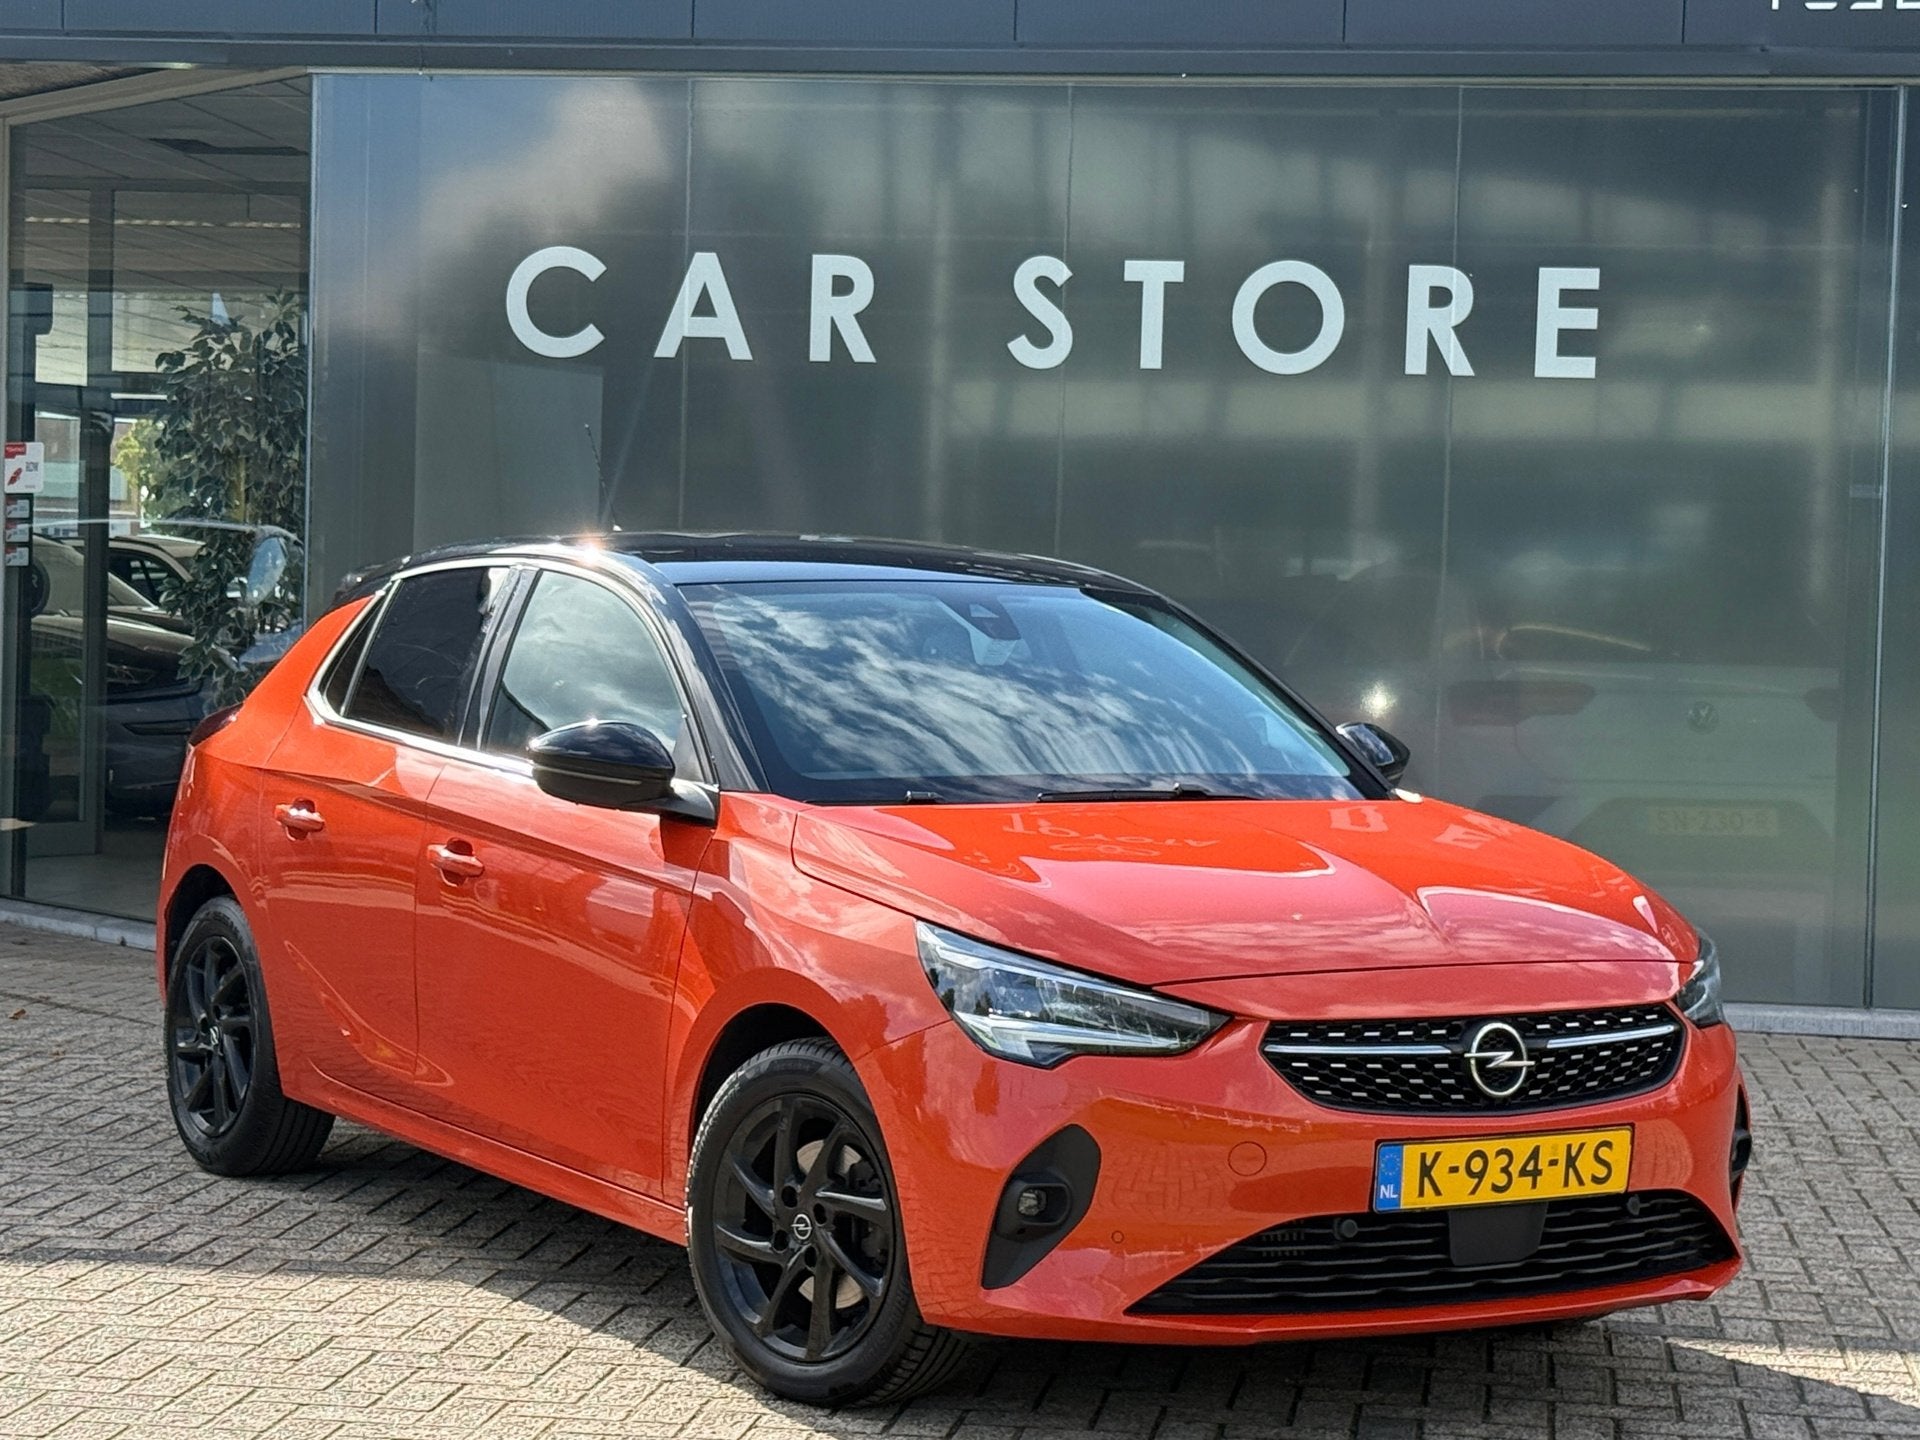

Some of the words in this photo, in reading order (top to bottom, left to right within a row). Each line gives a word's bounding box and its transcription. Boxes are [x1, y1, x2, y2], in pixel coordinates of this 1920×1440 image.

[506, 246, 877, 363] CAR
[1007, 255, 1600, 378] STORE
[1380, 1184, 1398, 1199] NL
[1418, 1140, 1613, 1198] K-934-KS
